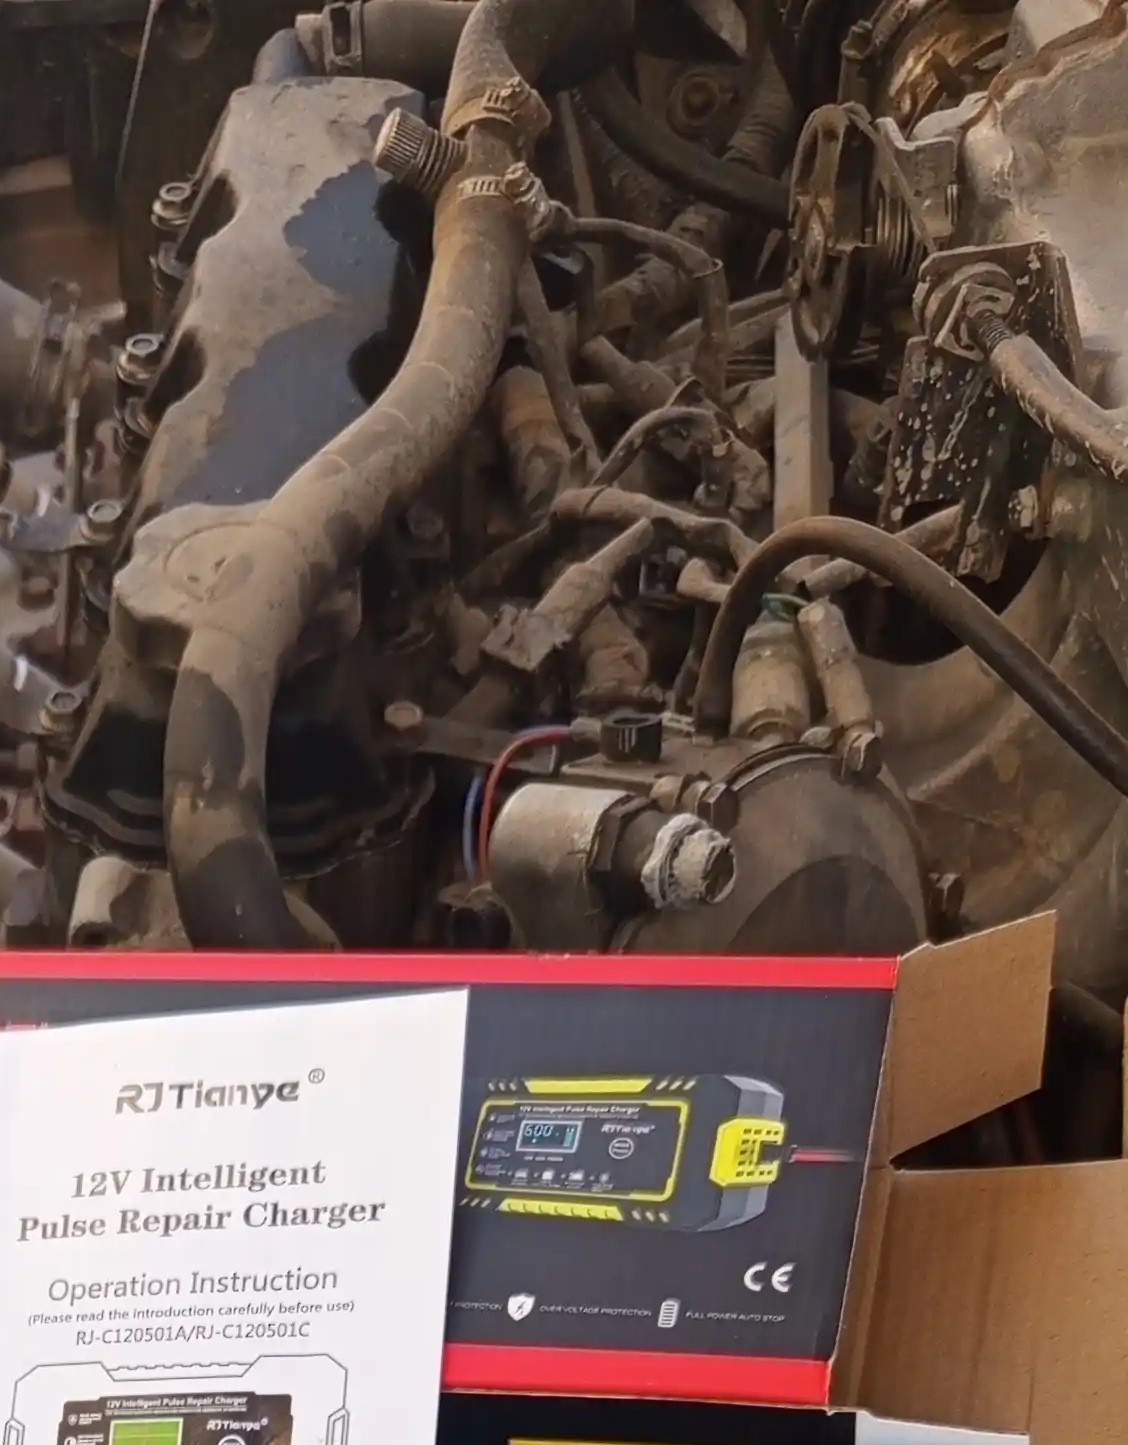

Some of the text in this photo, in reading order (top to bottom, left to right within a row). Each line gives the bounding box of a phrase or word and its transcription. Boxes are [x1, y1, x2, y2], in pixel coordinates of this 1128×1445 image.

[71, 1159, 327, 1199] 12V Intelligent
[16, 1199, 387, 1243] Pulse Repair Charger
[48, 1266, 339, 1307] Operation Instruction
[28, 1300, 355, 1327] (Please read the introduction carefully before use)
[600, 1307, 652, 1317] PROTECTION
[76, 1320, 311, 1347] RJ-C120501A/RJ-C120501C
